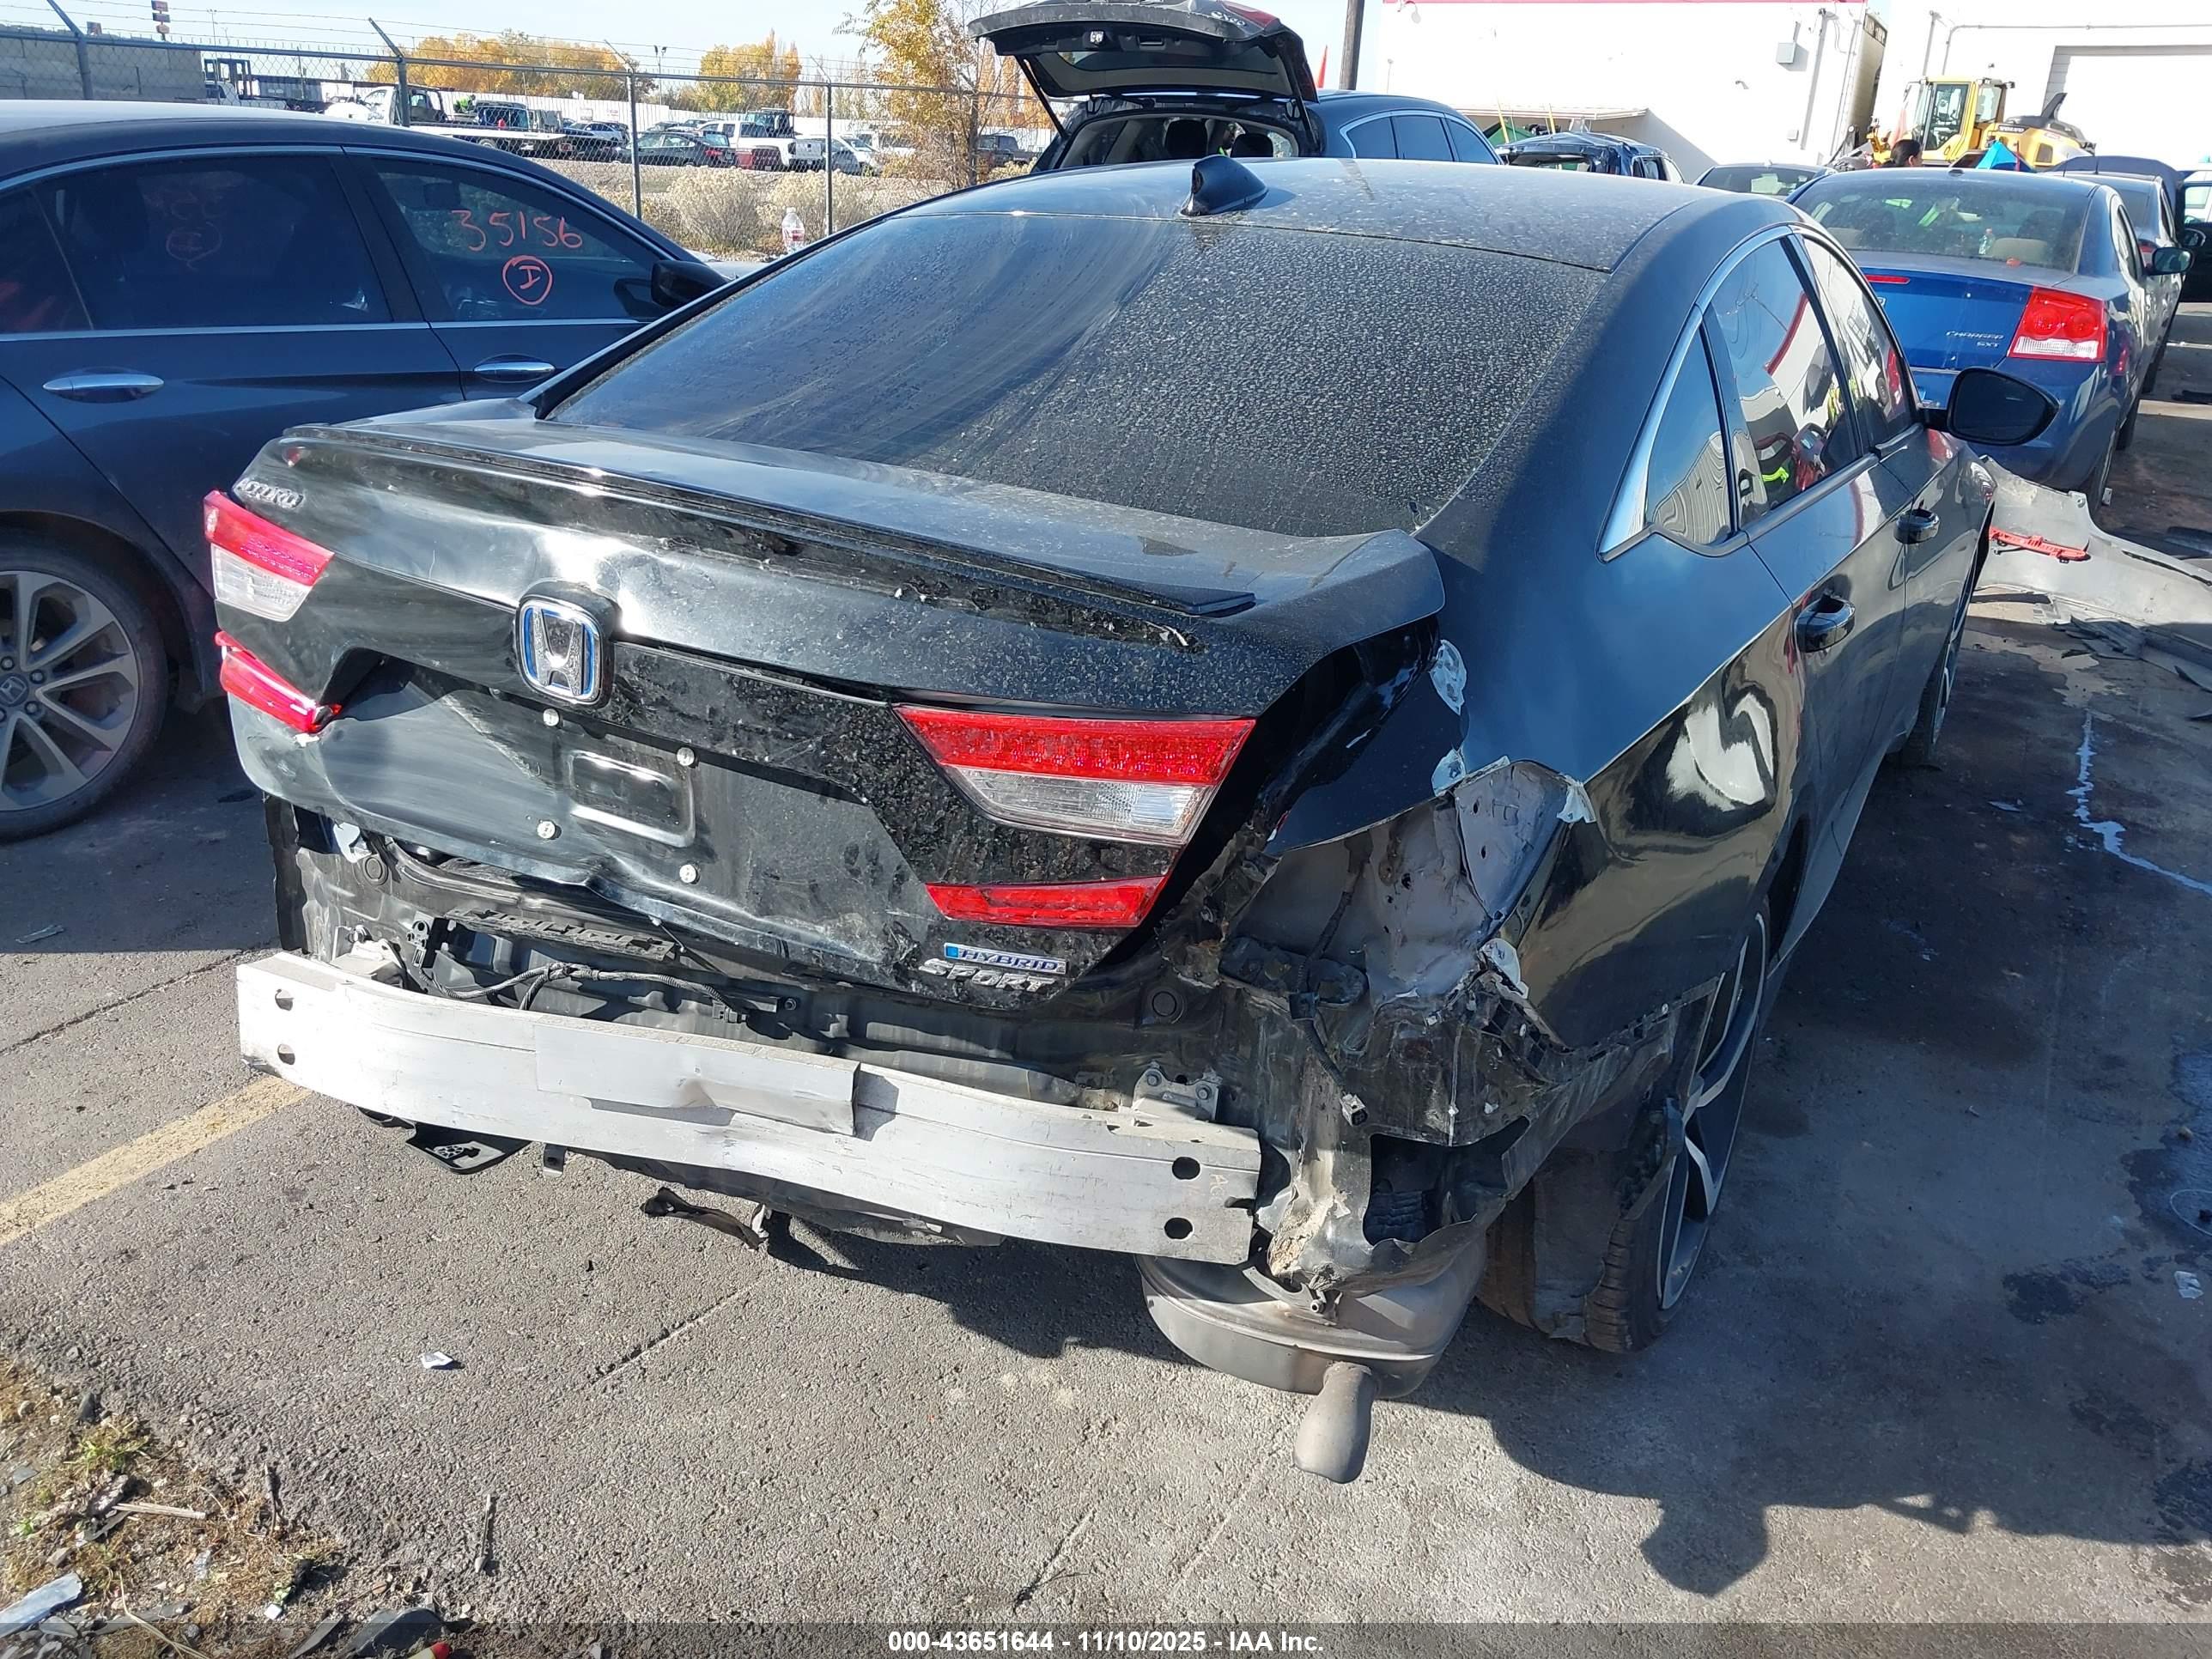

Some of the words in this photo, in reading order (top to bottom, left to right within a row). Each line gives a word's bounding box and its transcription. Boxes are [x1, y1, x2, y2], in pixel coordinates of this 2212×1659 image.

[451, 210, 583, 252] 35156
[234, 477, 302, 508] ACCORD
[918, 957, 1055, 993] SPORT
[961, 950, 1060, 971] HYBRID
